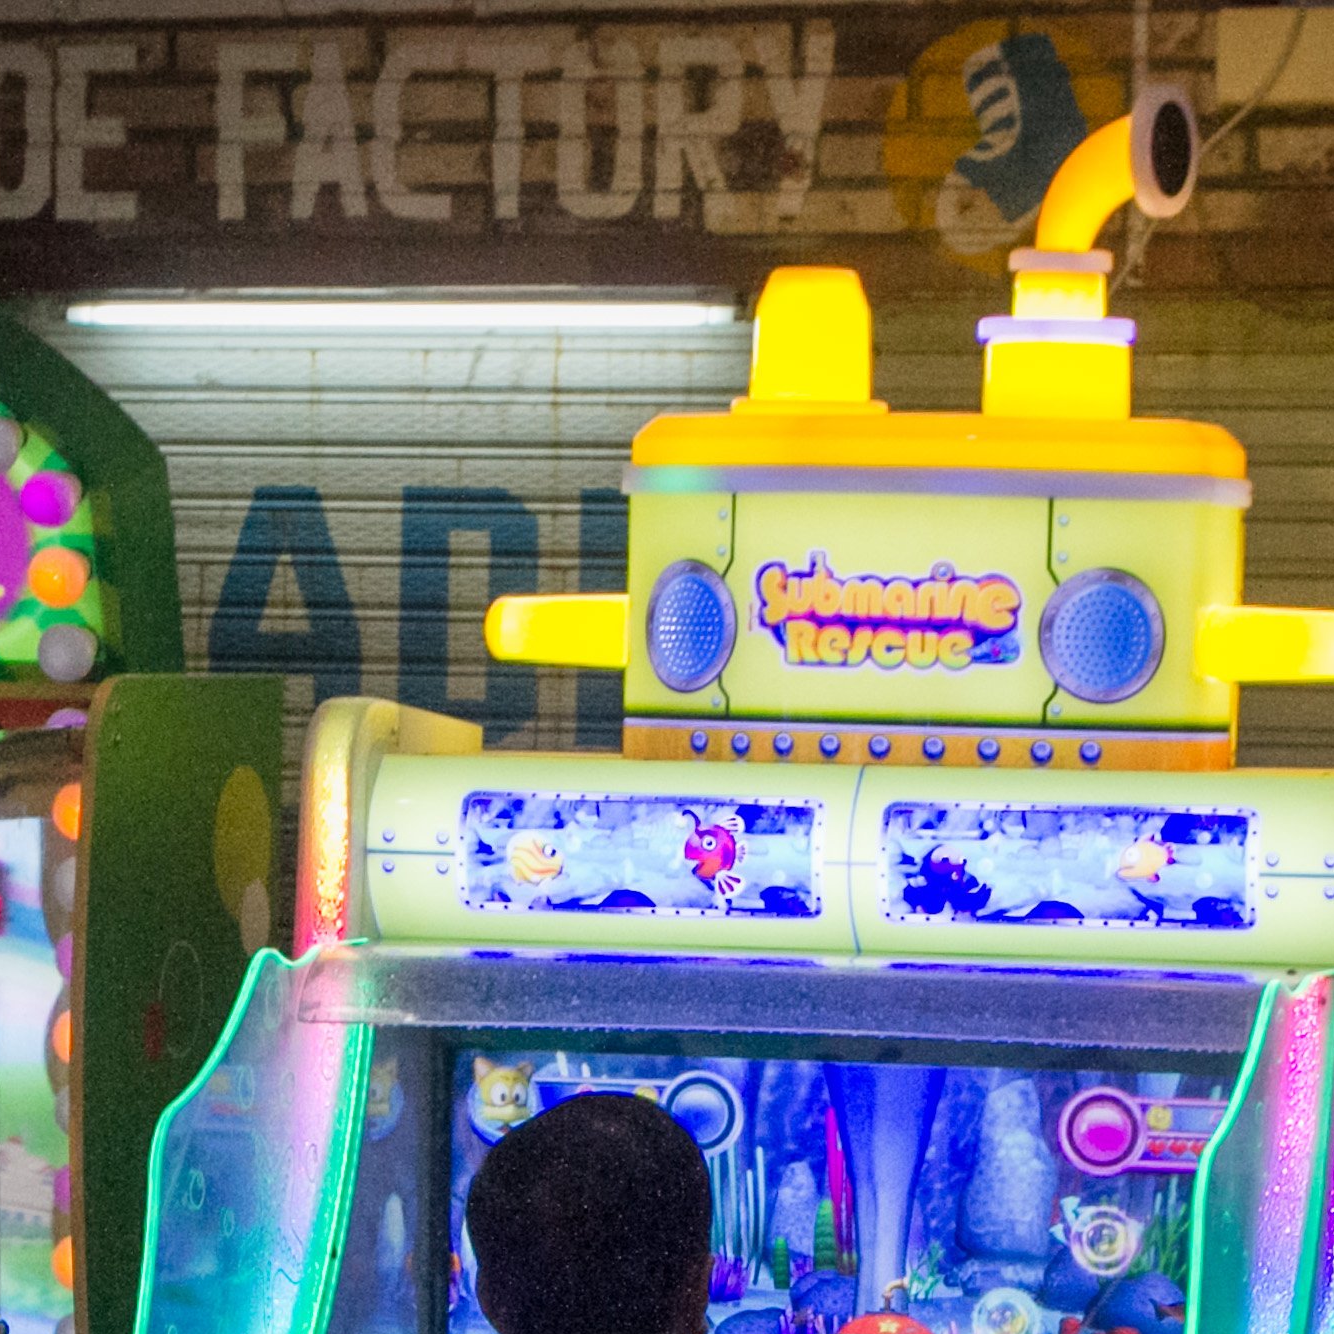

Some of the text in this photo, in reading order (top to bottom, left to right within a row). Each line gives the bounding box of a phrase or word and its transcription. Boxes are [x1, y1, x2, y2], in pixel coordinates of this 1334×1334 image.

[214, 18, 837, 222] FACTORY
[755, 558, 1023, 632] Submarine
[783, 618, 976, 670] Rescue
